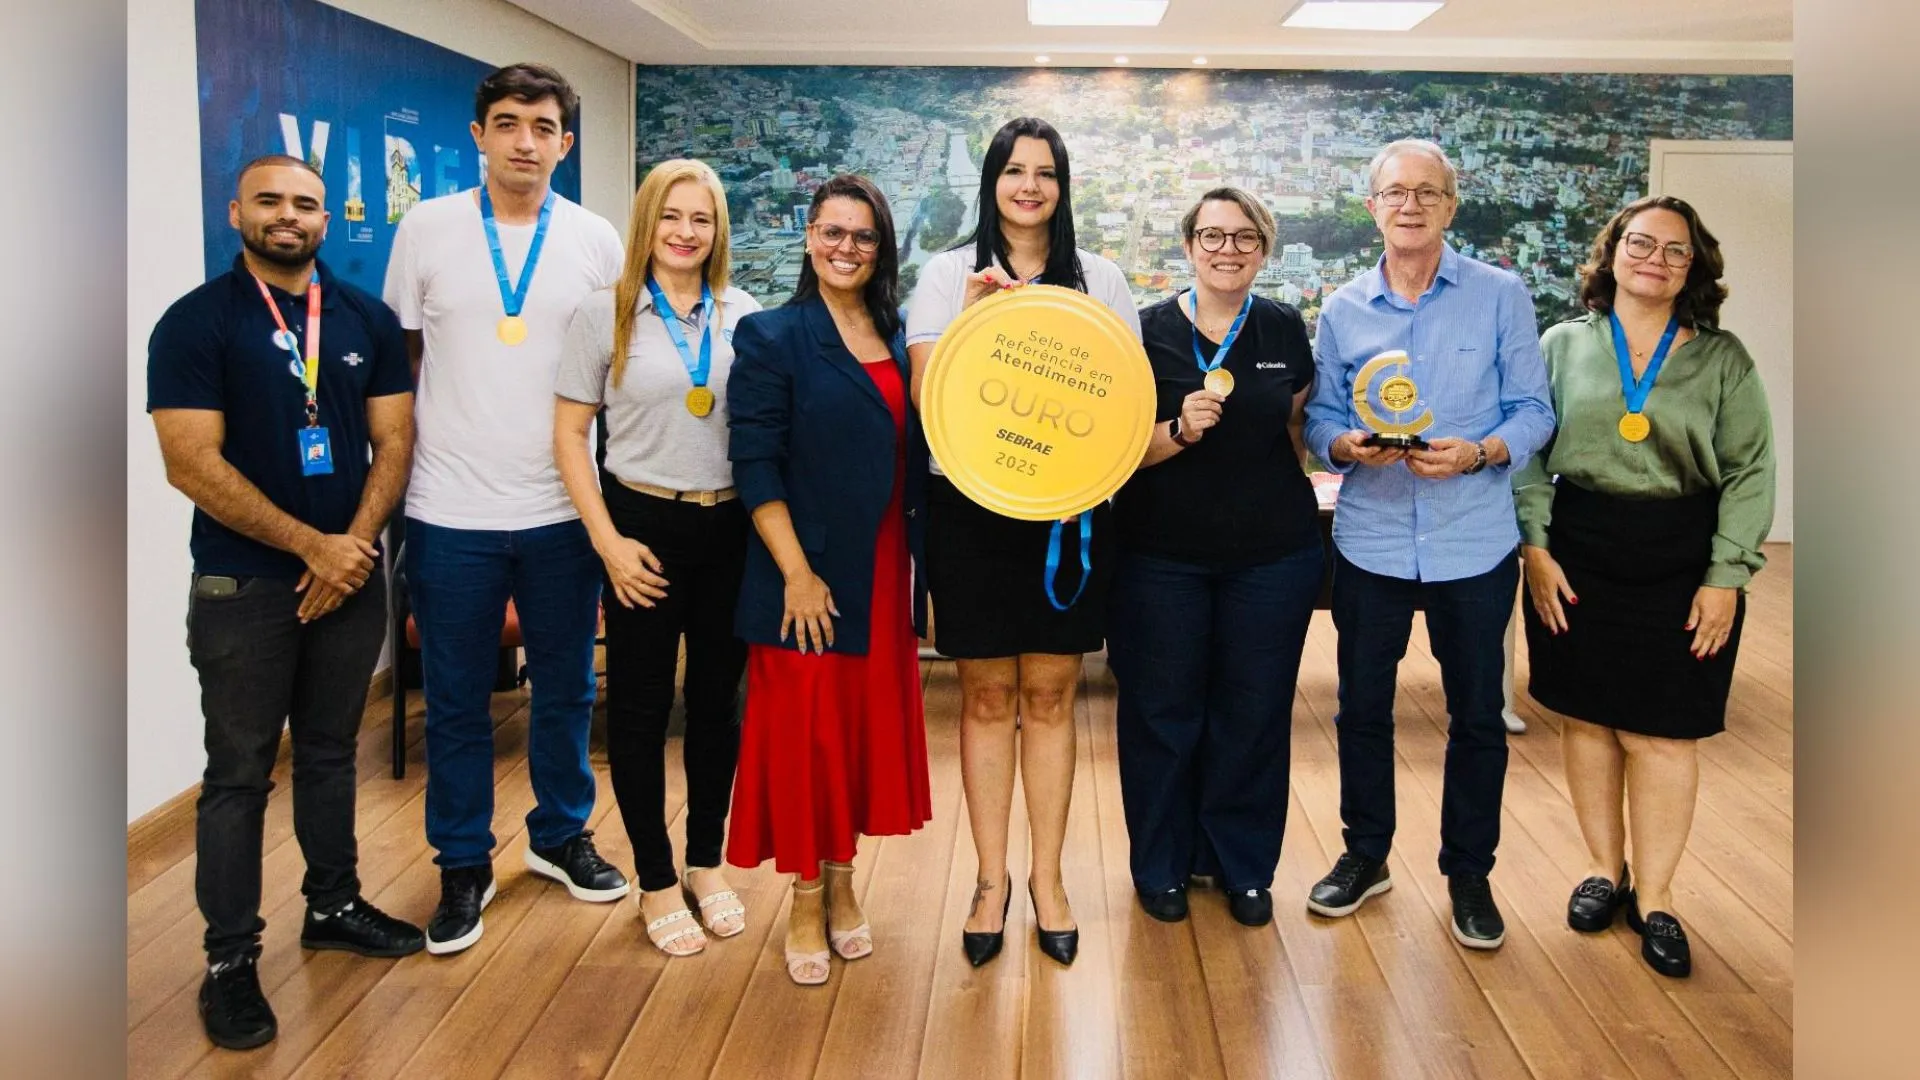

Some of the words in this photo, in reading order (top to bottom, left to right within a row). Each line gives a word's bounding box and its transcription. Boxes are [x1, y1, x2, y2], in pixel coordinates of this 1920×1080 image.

[995, 333, 1082, 374] Referência
[1089, 368, 1113, 385] em
[1028, 331, 1063, 351] Selo
[1070, 346, 1089, 361] de
[990, 349, 1107, 398] Atendimento
[979, 378, 1095, 438] OURO
[996, 428, 1053, 456] SEBRAE
[995, 452, 1038, 477] 2025
